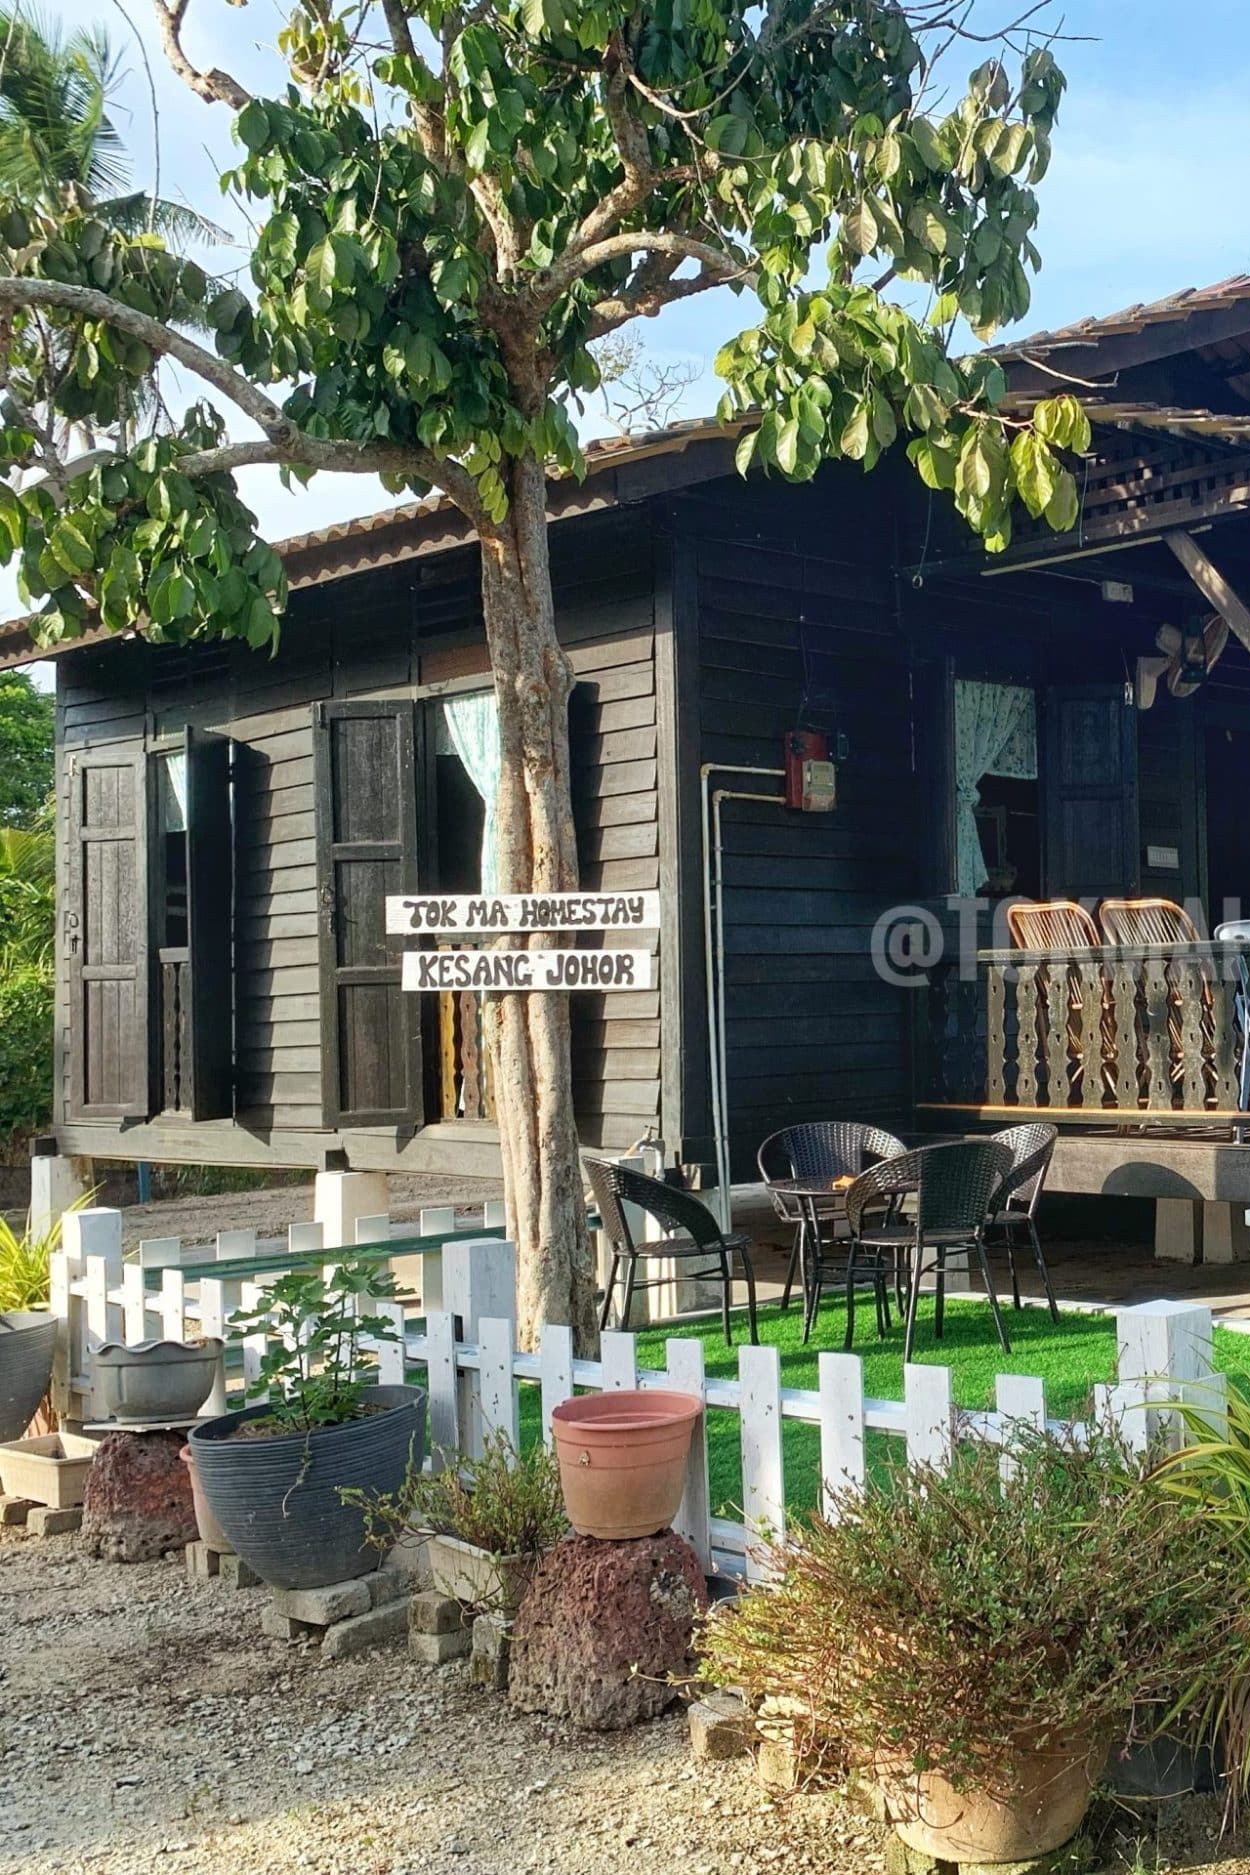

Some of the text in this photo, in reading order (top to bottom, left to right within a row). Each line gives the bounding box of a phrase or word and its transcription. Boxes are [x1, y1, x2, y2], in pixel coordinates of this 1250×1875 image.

[403, 896, 645, 929] TOK MA HOMESTAY
[418, 953, 635, 988] KESANG JOHOR
